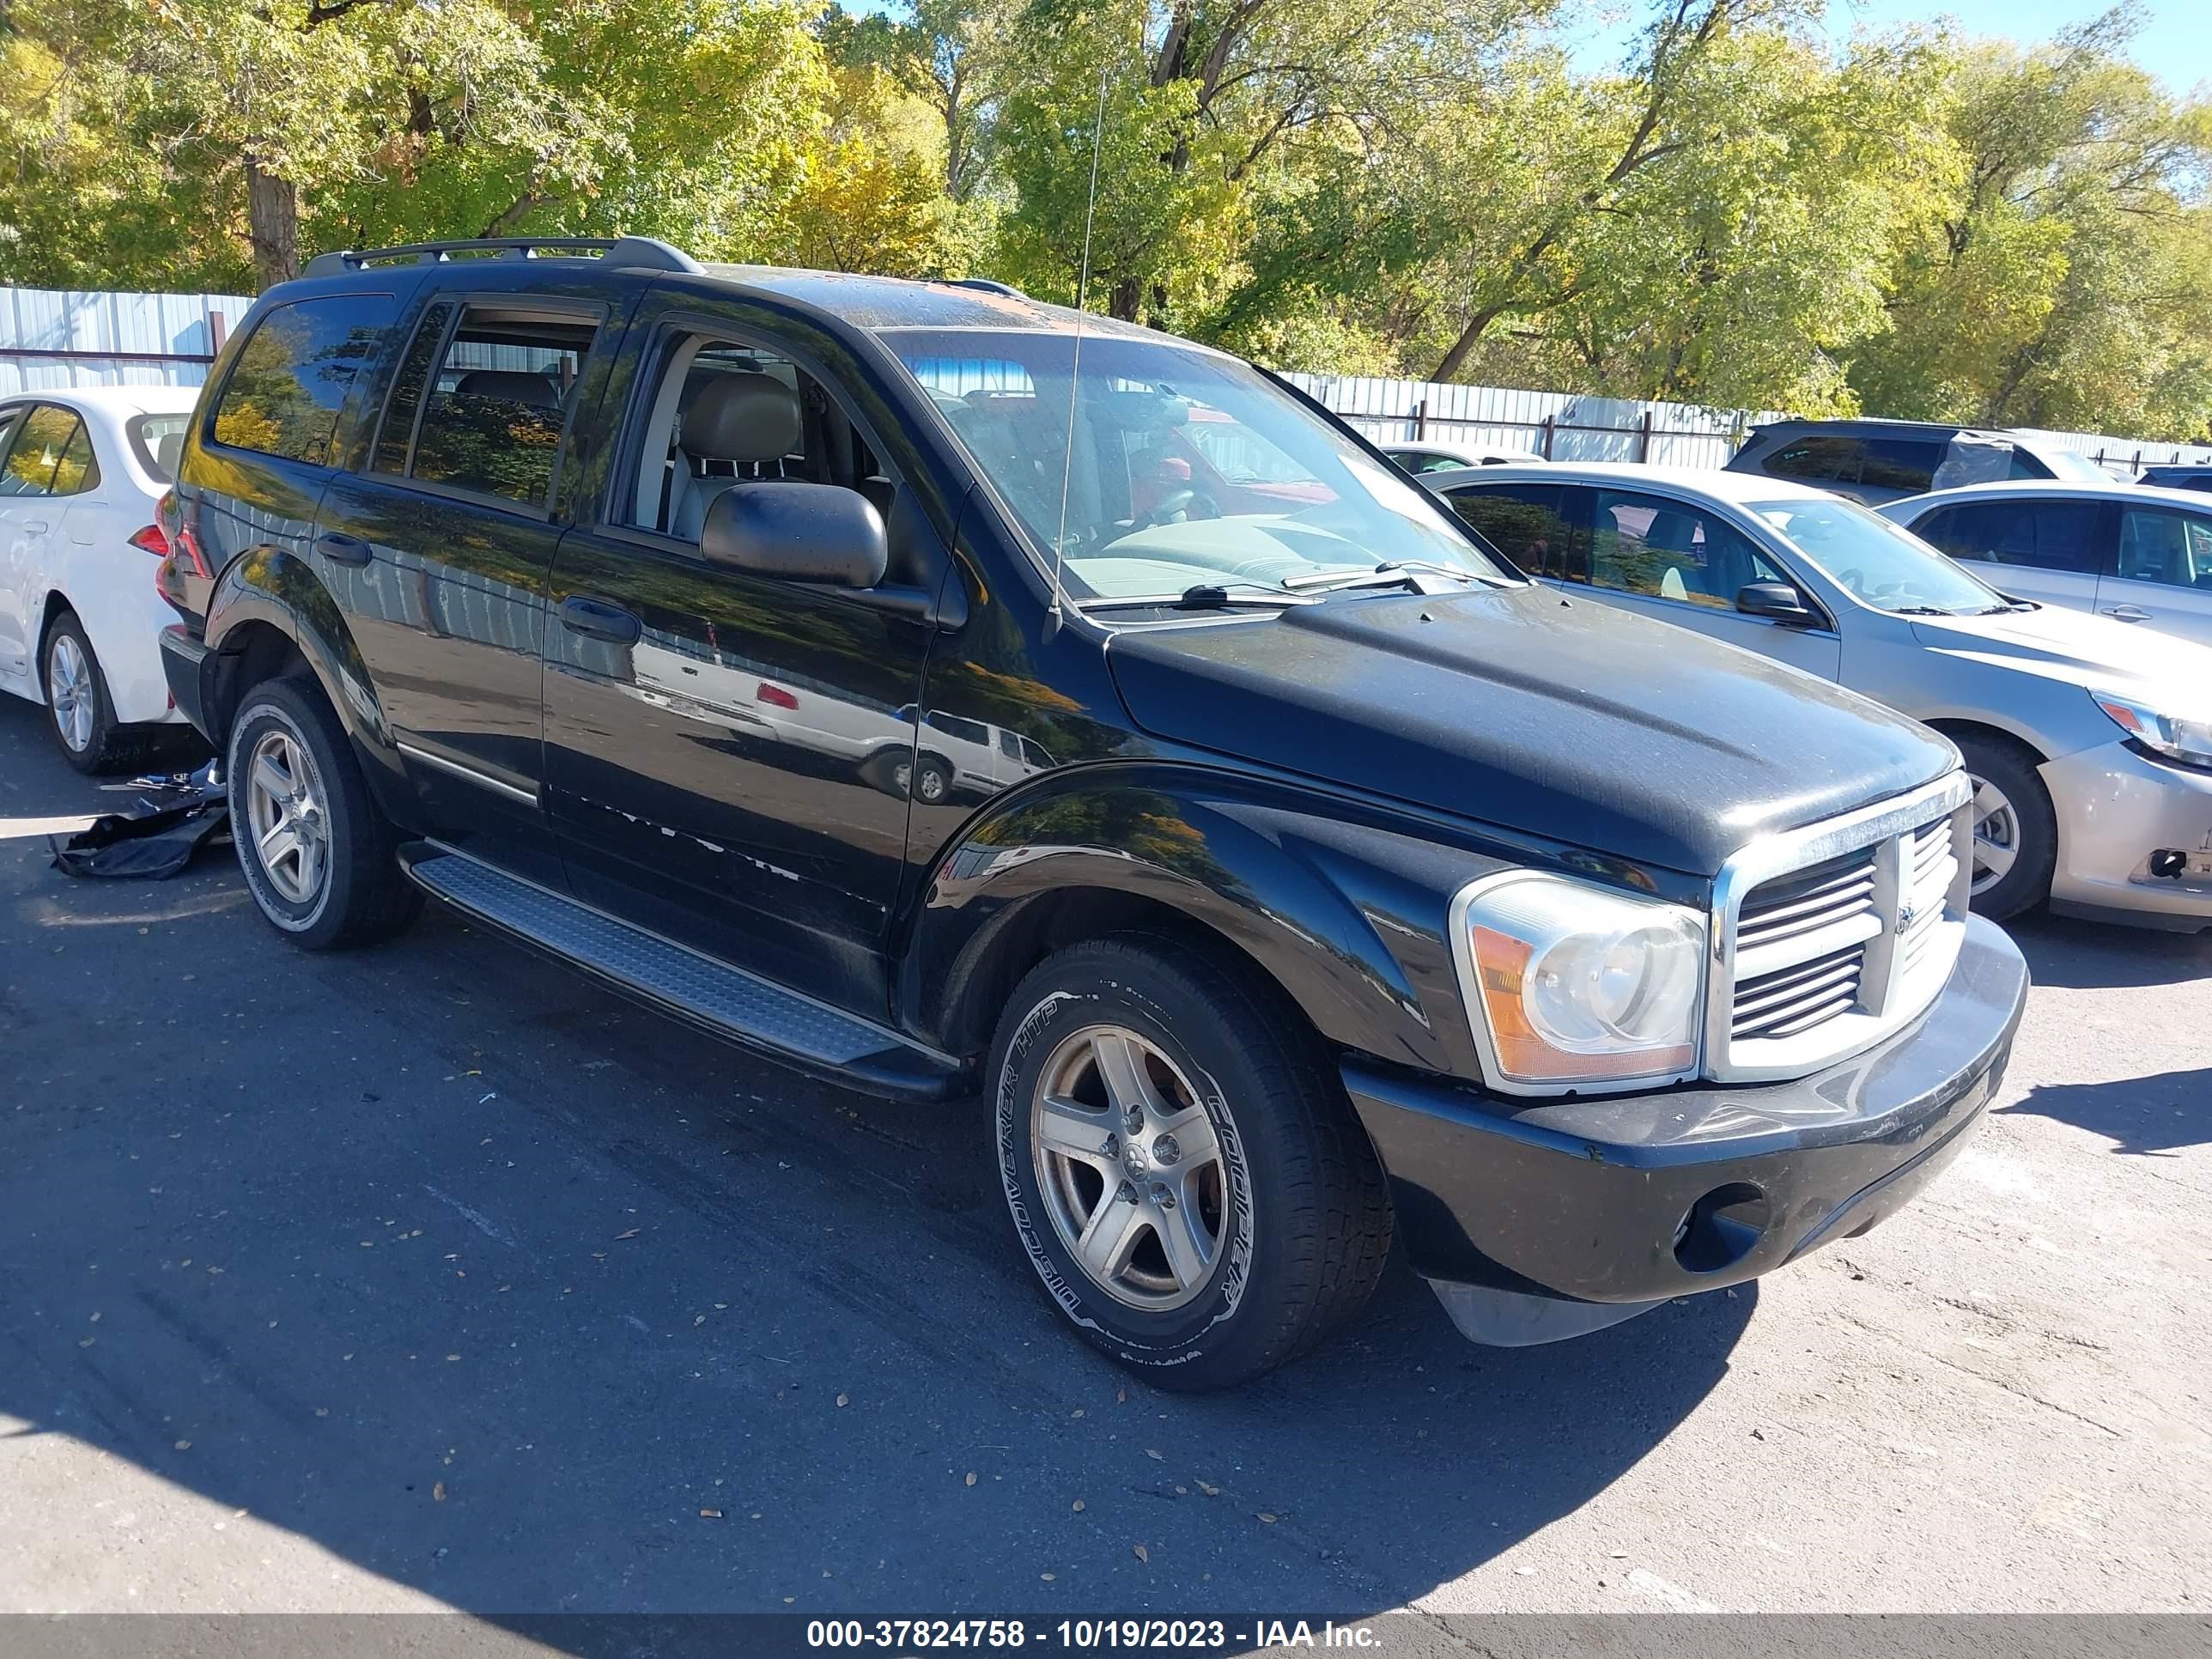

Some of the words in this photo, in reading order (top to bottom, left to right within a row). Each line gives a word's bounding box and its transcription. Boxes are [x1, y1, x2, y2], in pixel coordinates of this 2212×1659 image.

[1015, 999, 1059, 1058] HTP
[998, 1064, 1081, 1310] DISCOVERER
[1206, 1095, 1249, 1304] COOPER
